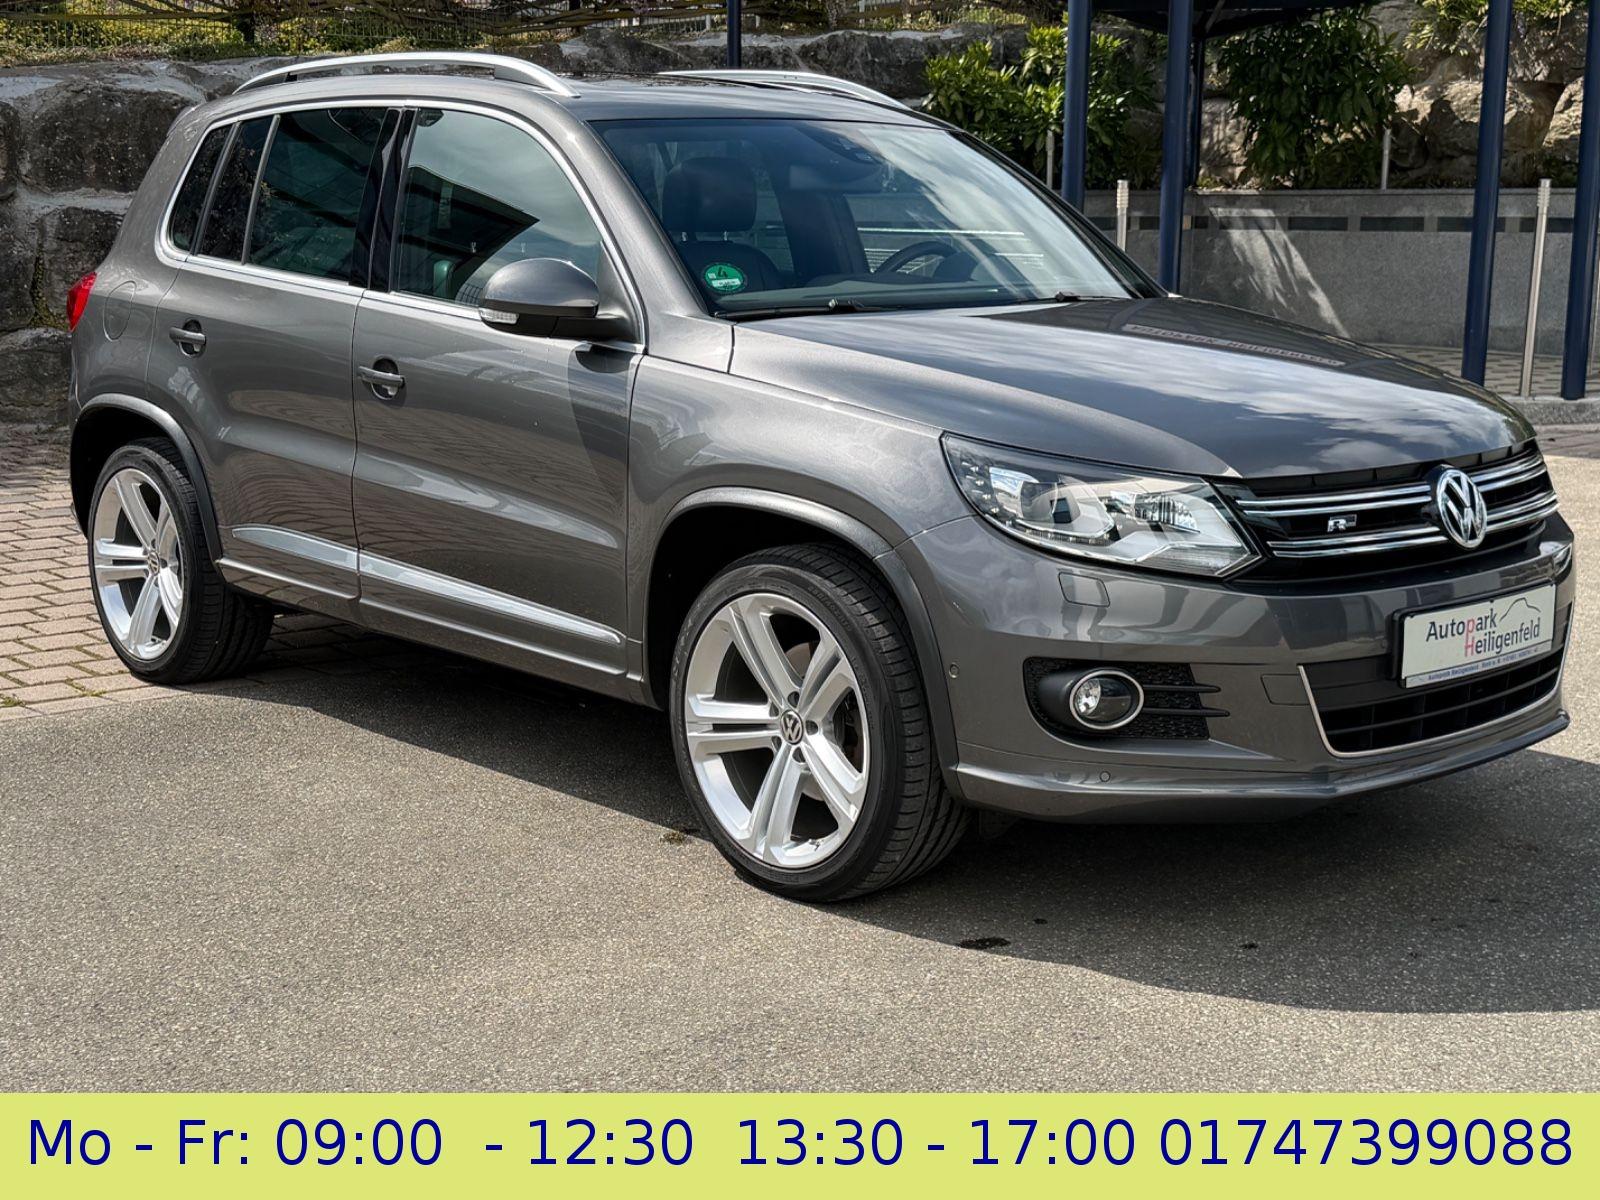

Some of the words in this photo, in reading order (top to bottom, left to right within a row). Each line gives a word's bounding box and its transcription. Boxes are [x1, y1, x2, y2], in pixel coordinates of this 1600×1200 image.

[1327, 516, 1352, 533] R
[1437, 469, 1487, 548] VW
[1426, 608, 1498, 642] Autopark
[1465, 617, 1541, 657] Heiligenfeld
